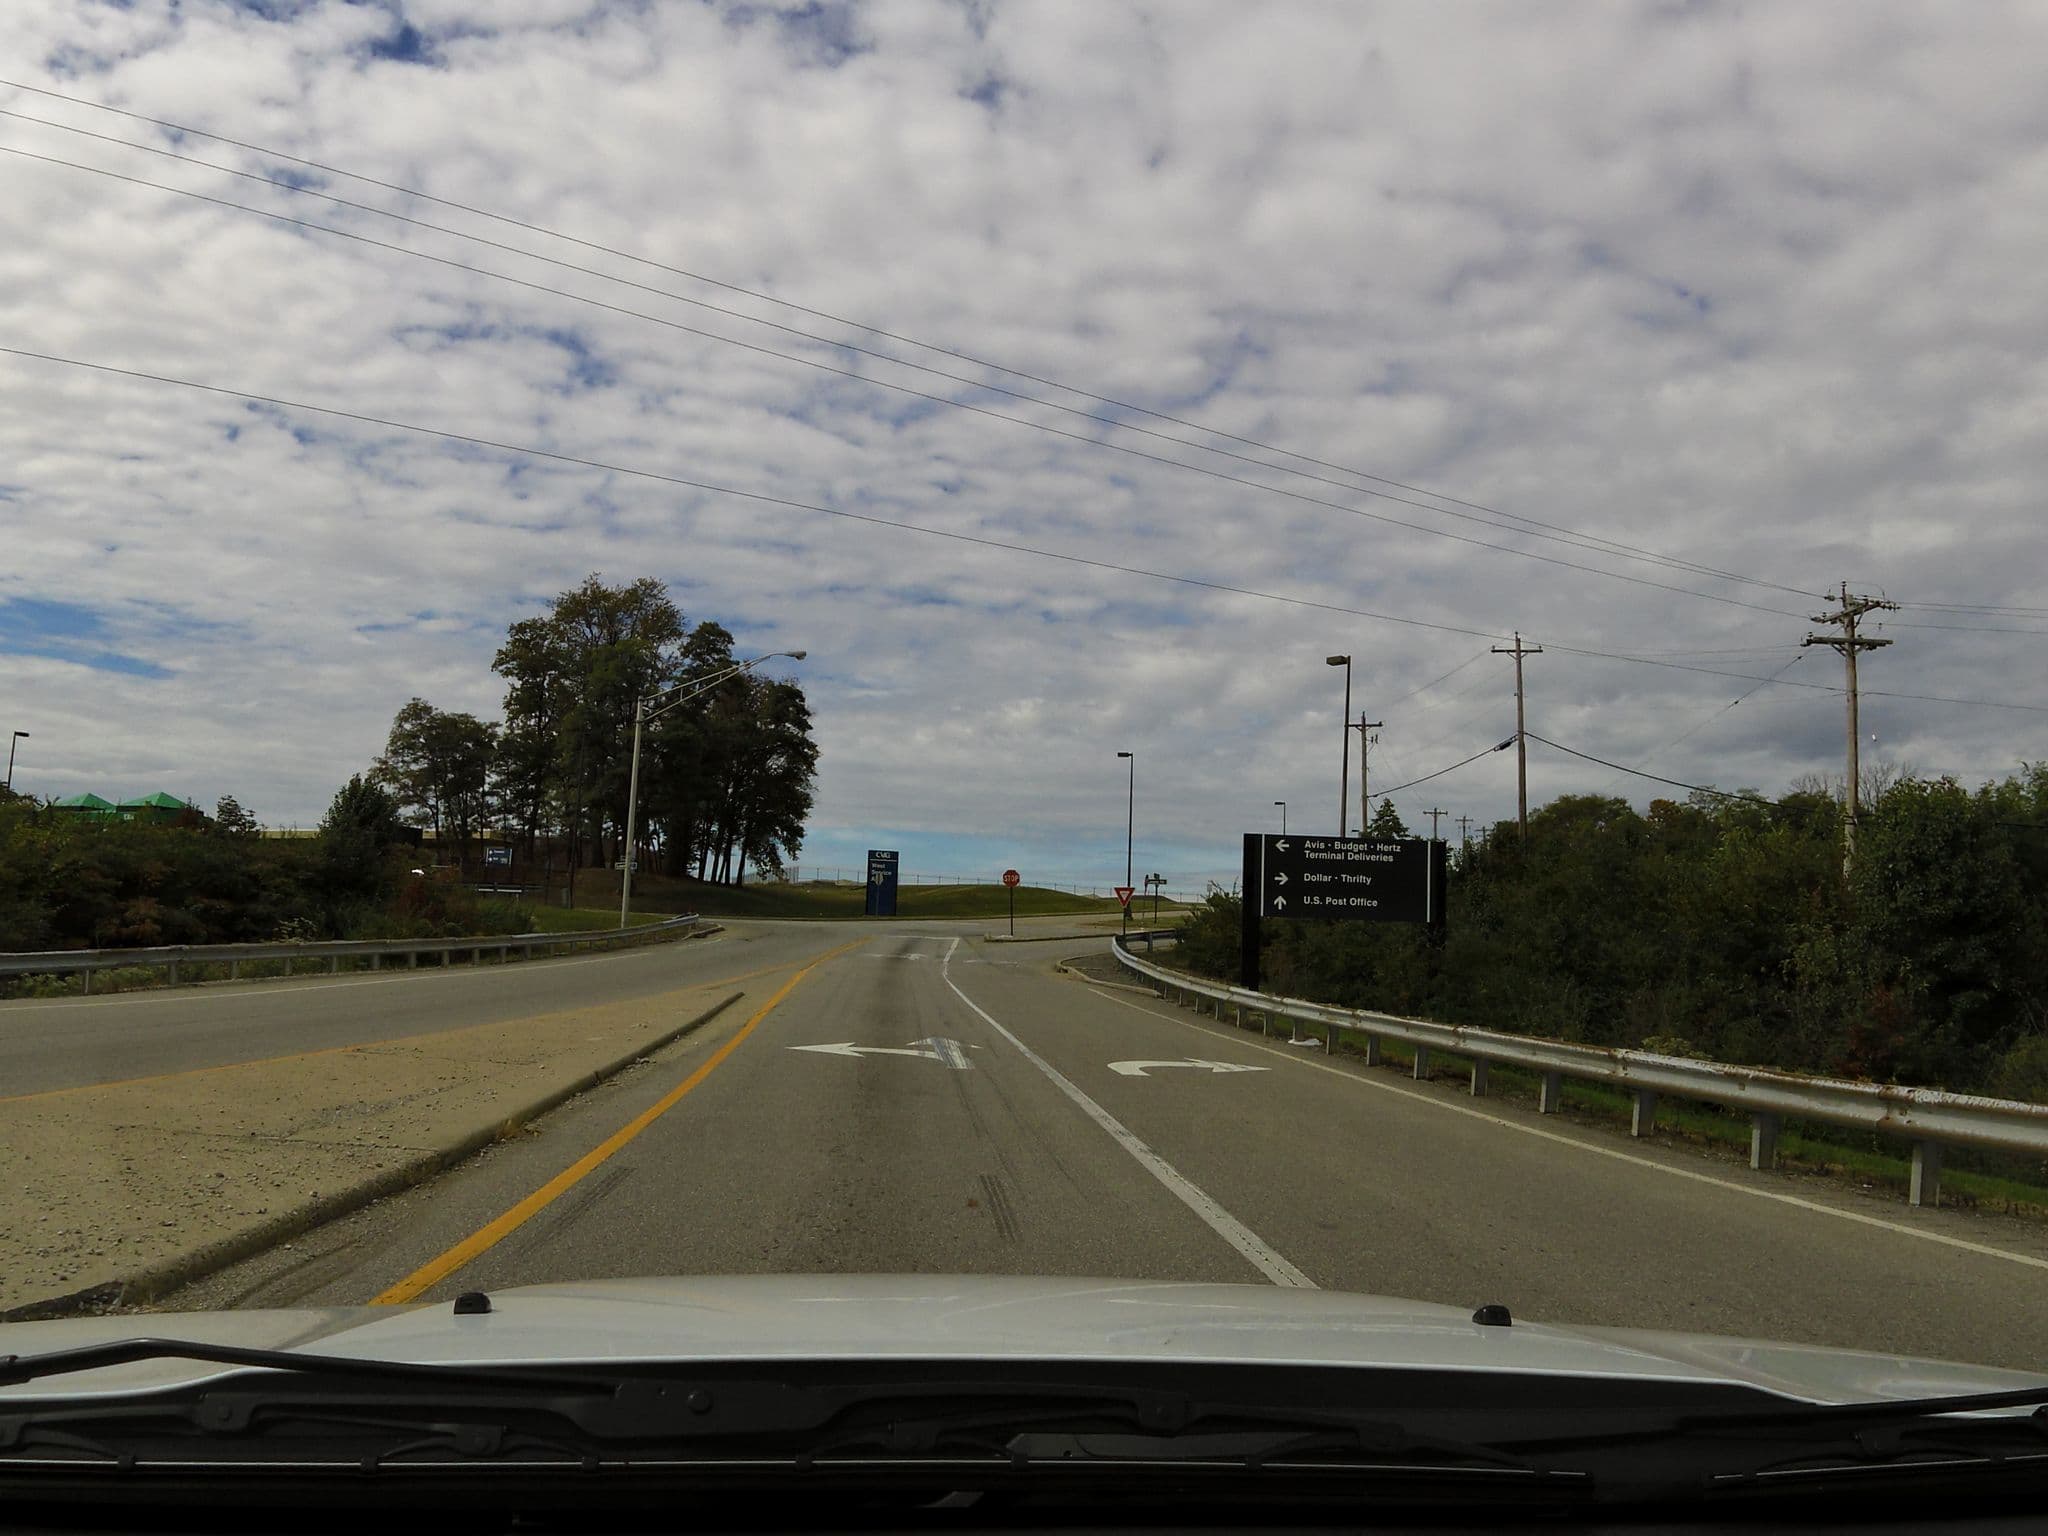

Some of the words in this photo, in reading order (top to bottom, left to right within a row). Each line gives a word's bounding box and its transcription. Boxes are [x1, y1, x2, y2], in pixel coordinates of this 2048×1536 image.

[1304, 840, 1325, 849] Avis
[1334, 842, 1368, 852] Budget
[1376, 843, 1401, 852] Hertz
[1304, 850, 1345, 860] Terminal
[1347, 852, 1394, 862] Deliveries
[1304, 873, 1332, 882] Dollar
[1341, 874, 1372, 885] Thrifty
[1303, 896, 1323, 905] U.S.
[1325, 897, 1347, 906] Post
[1349, 898, 1378, 907] Office
